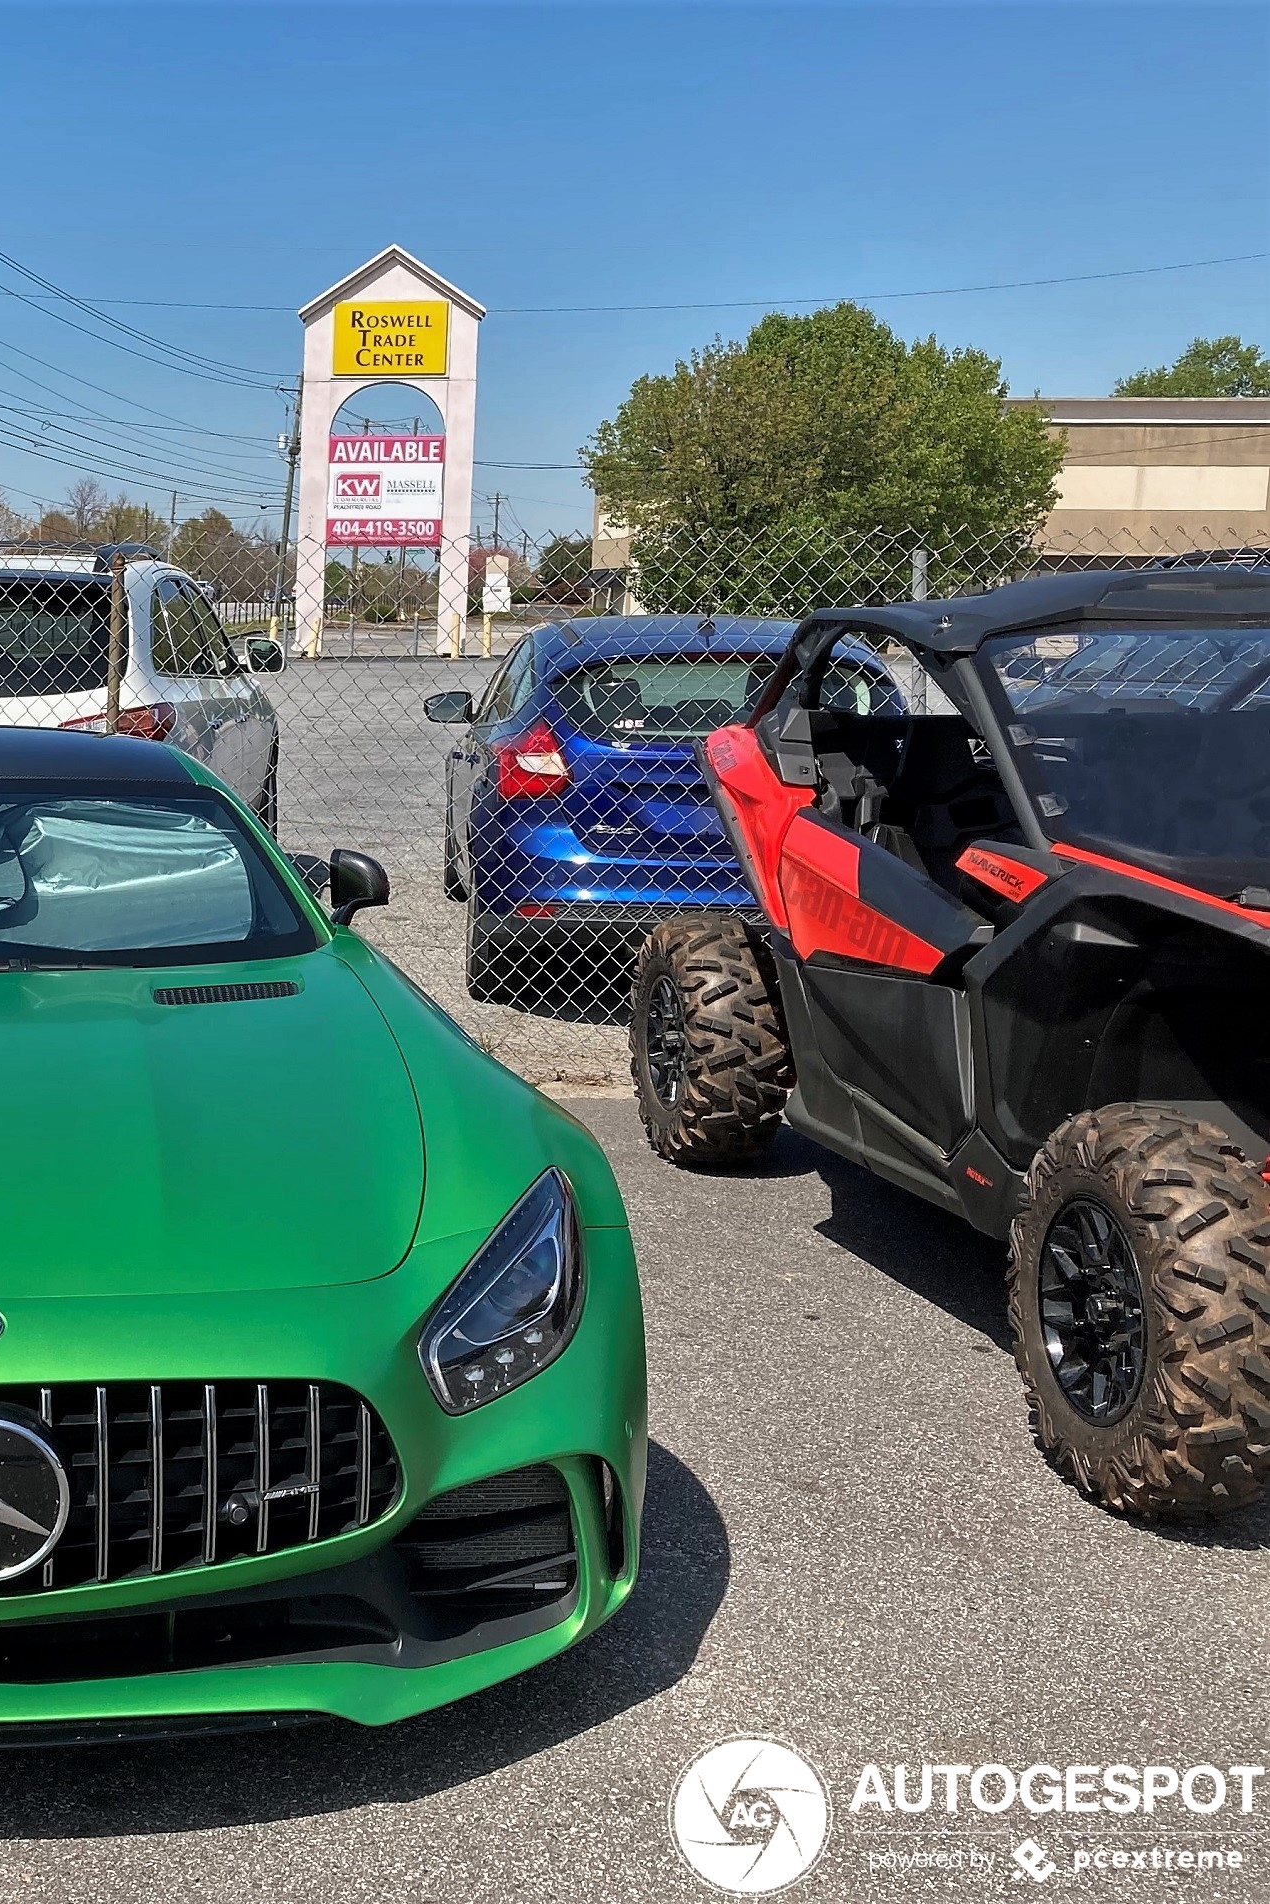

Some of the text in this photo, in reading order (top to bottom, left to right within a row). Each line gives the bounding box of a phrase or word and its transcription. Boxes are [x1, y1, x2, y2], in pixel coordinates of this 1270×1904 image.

[351, 310, 432, 328] ROSWELL
[357, 329, 416, 347] TRADE
[355, 348, 424, 367] CENTER
[332, 441, 441, 462] AVAILABLE
[336, 478, 380, 496] KW
[386, 480, 436, 489] MASSELL
[332, 520, 435, 537] 404-419-3500
[783, 863, 910, 967] can-am
